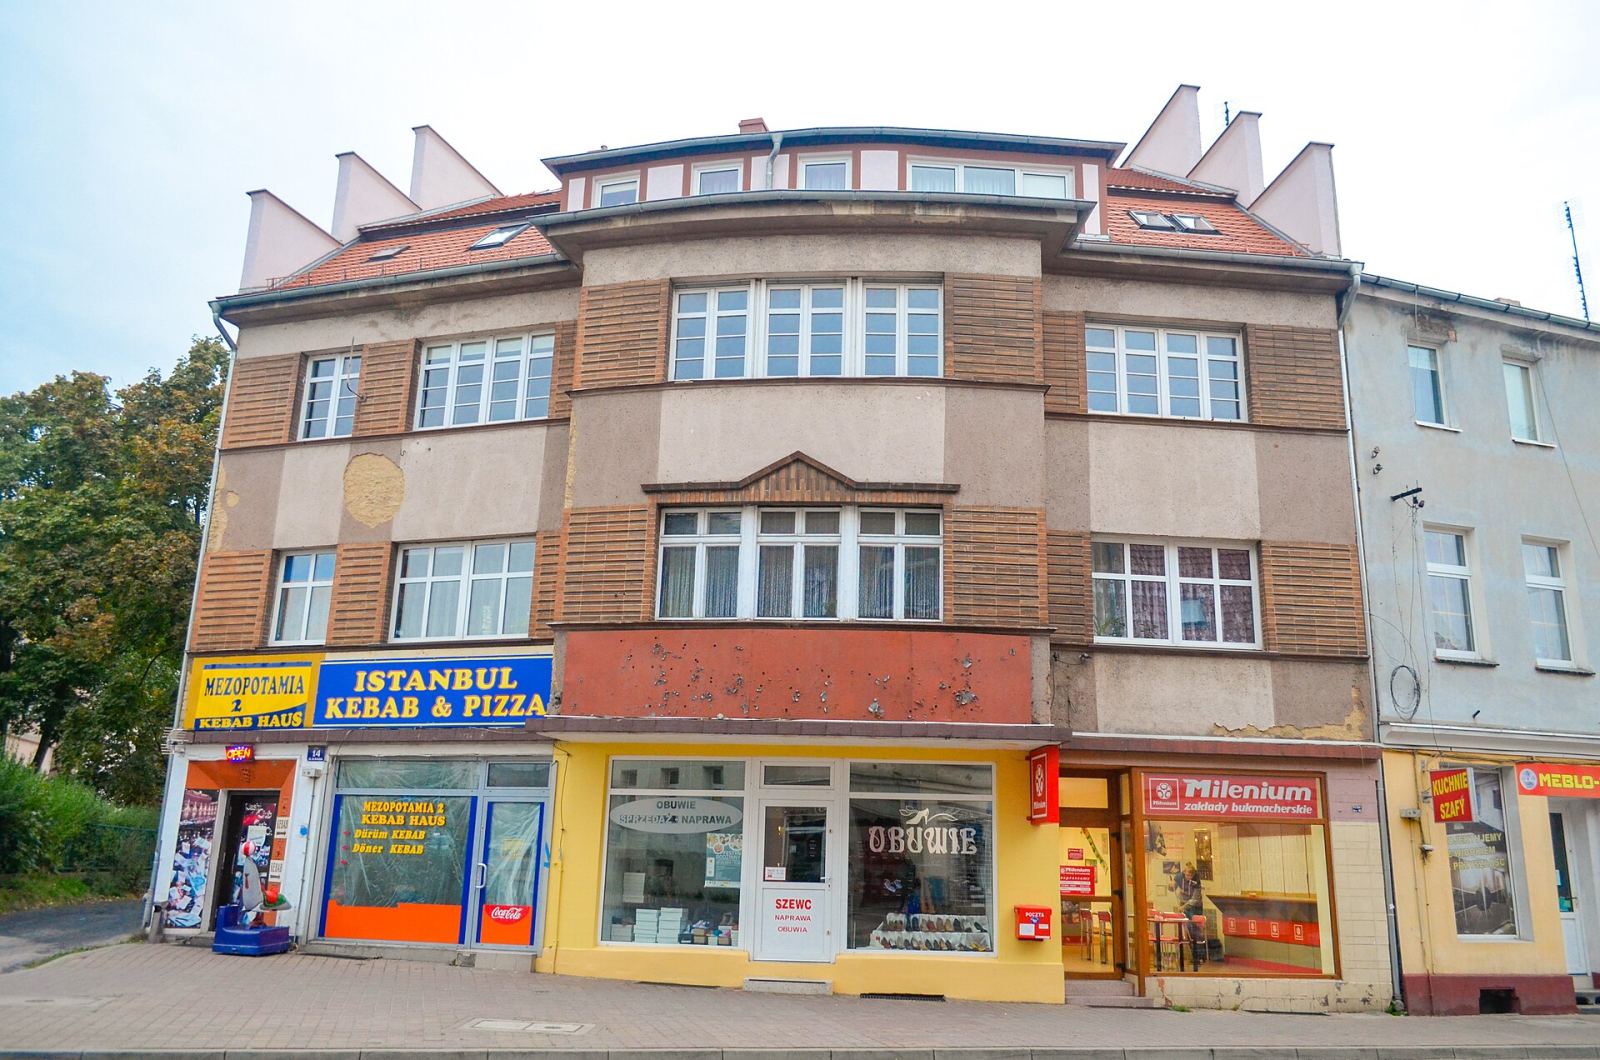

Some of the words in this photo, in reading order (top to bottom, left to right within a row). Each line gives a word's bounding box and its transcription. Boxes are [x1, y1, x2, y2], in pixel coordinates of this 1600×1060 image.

[204, 675, 304, 696] MEZOPOTAMIA
[353, 667, 518, 692] ISTANBUL
[231, 699, 242, 712] 2
[324, 697, 419, 719] KEBAB
[431, 696, 452, 717] &
[461, 694, 548, 717] PIZZA
[199, 718, 253, 729] KEBAB
[257, 711, 303, 727] HAUS
[226, 748, 251, 759] OPEN
[312, 749, 321, 758] 14
[1183, 778, 1312, 801] Milenium
[1432, 772, 1468, 796] KUCHNIE
[363, 801, 434, 814] MEZOPOTAMIA
[437, 803, 445, 814] 2
[656, 801, 696, 810] OBUWIE
[1231, 803, 1313, 815] bukmacherskie
[361, 815, 405, 825] KEBAB
[409, 815, 446, 826] HAUS
[681, 815, 732, 824] NAPRAWA
[354, 829, 388, 839] Dürüm
[391, 830, 426, 840] KEBAB
[868, 825, 978, 855] OBUWIE
[352, 843, 383, 854] Döner
[389, 844, 425, 855] KEBAB
[775, 898, 812, 910] SZEWC
